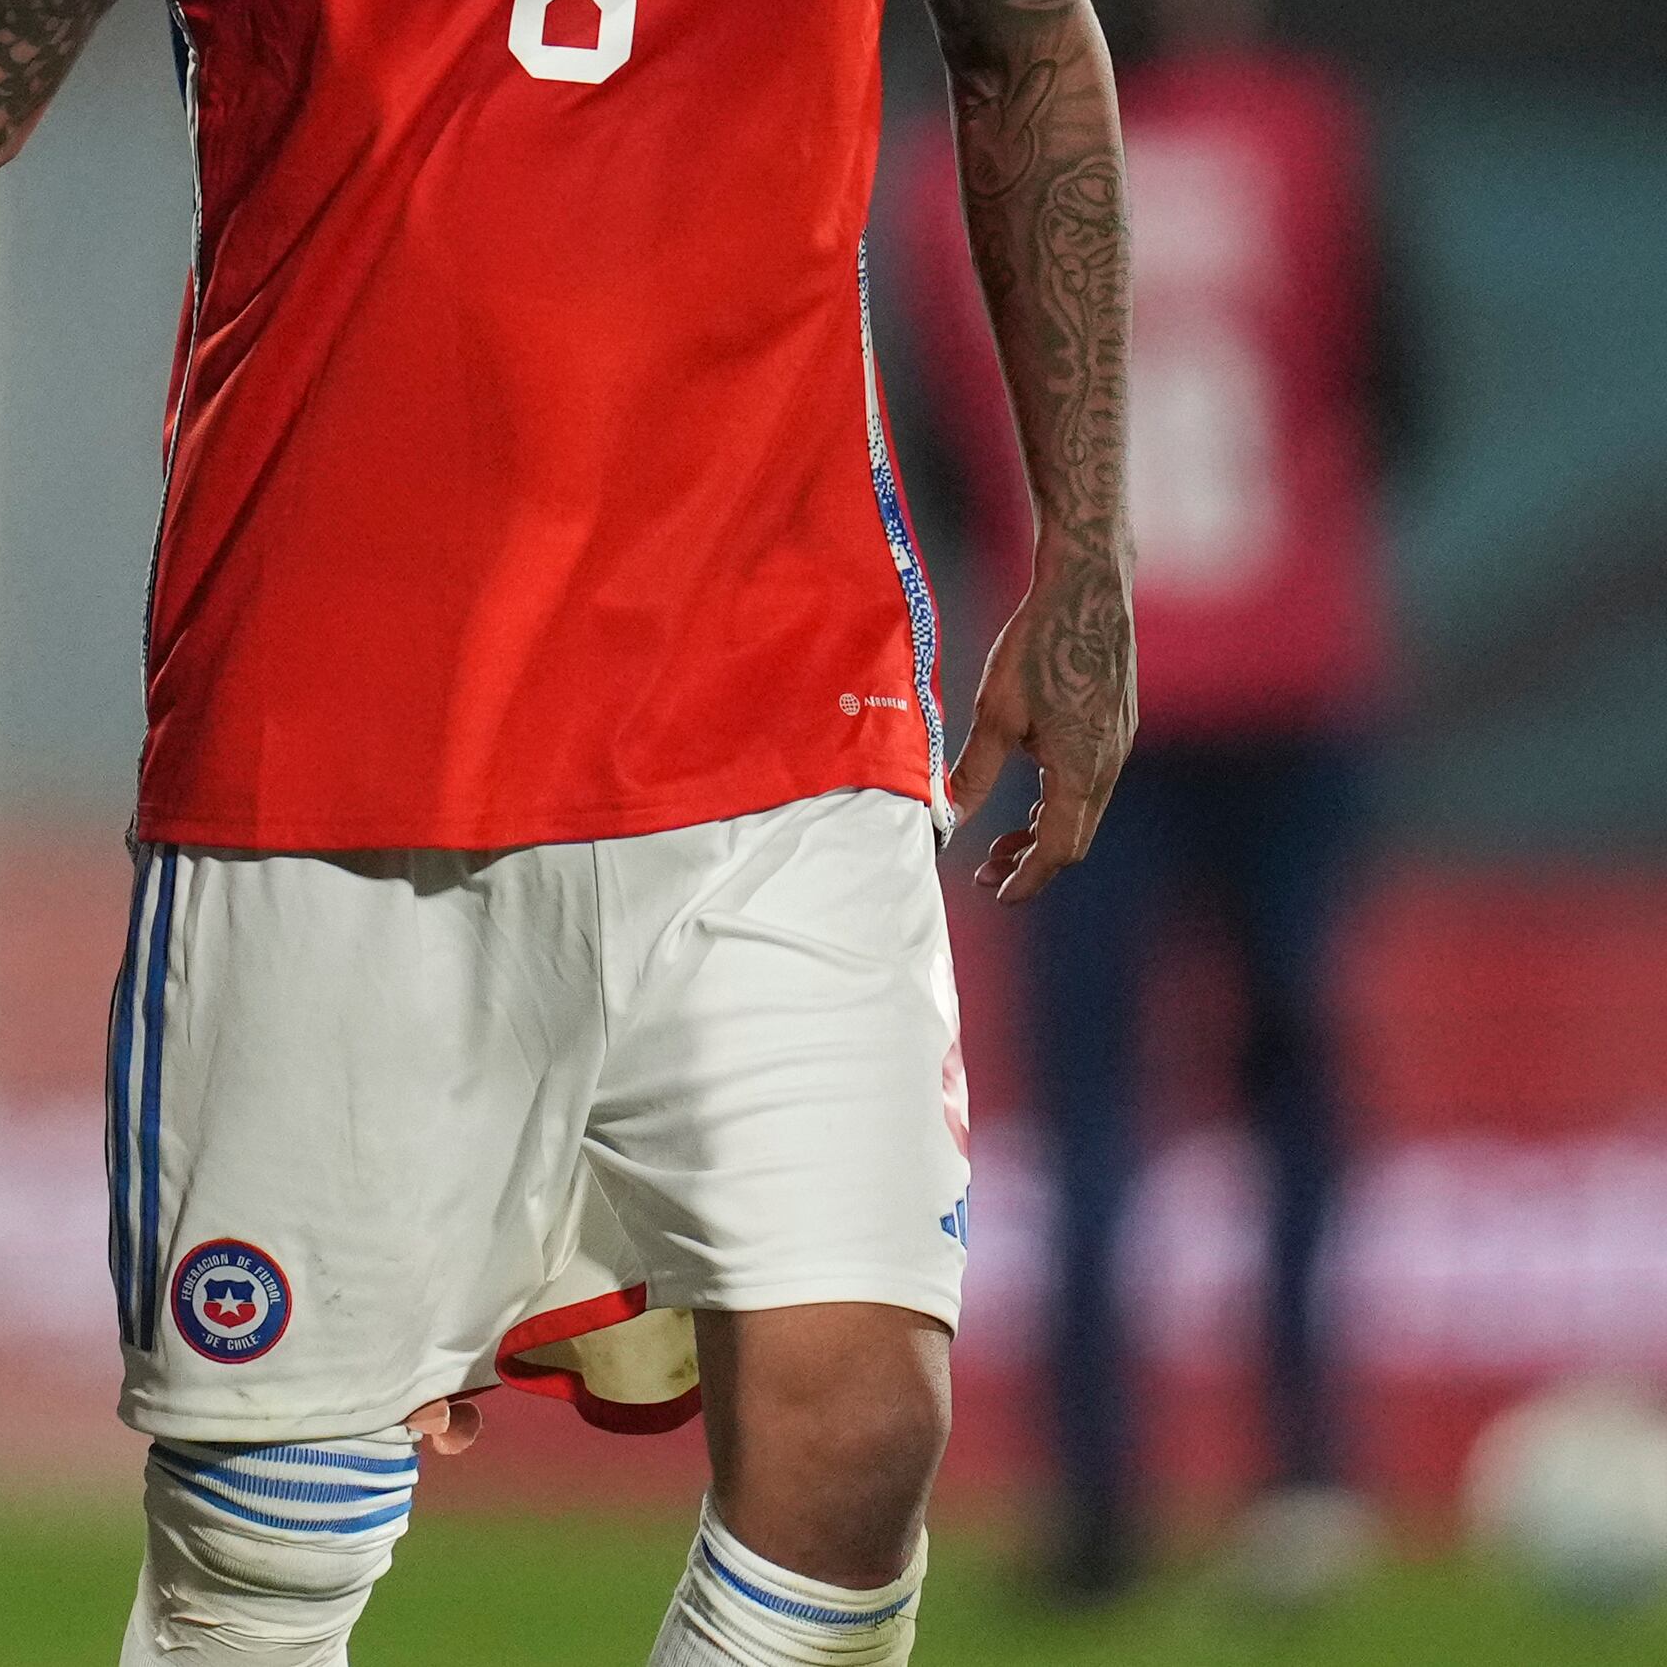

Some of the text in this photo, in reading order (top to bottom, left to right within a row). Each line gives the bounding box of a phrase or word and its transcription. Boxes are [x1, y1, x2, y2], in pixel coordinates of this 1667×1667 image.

[181, 1253, 282, 1305] FEDERACION DE FUTBOL
[204, 1334, 260, 1351] DE CHILE
